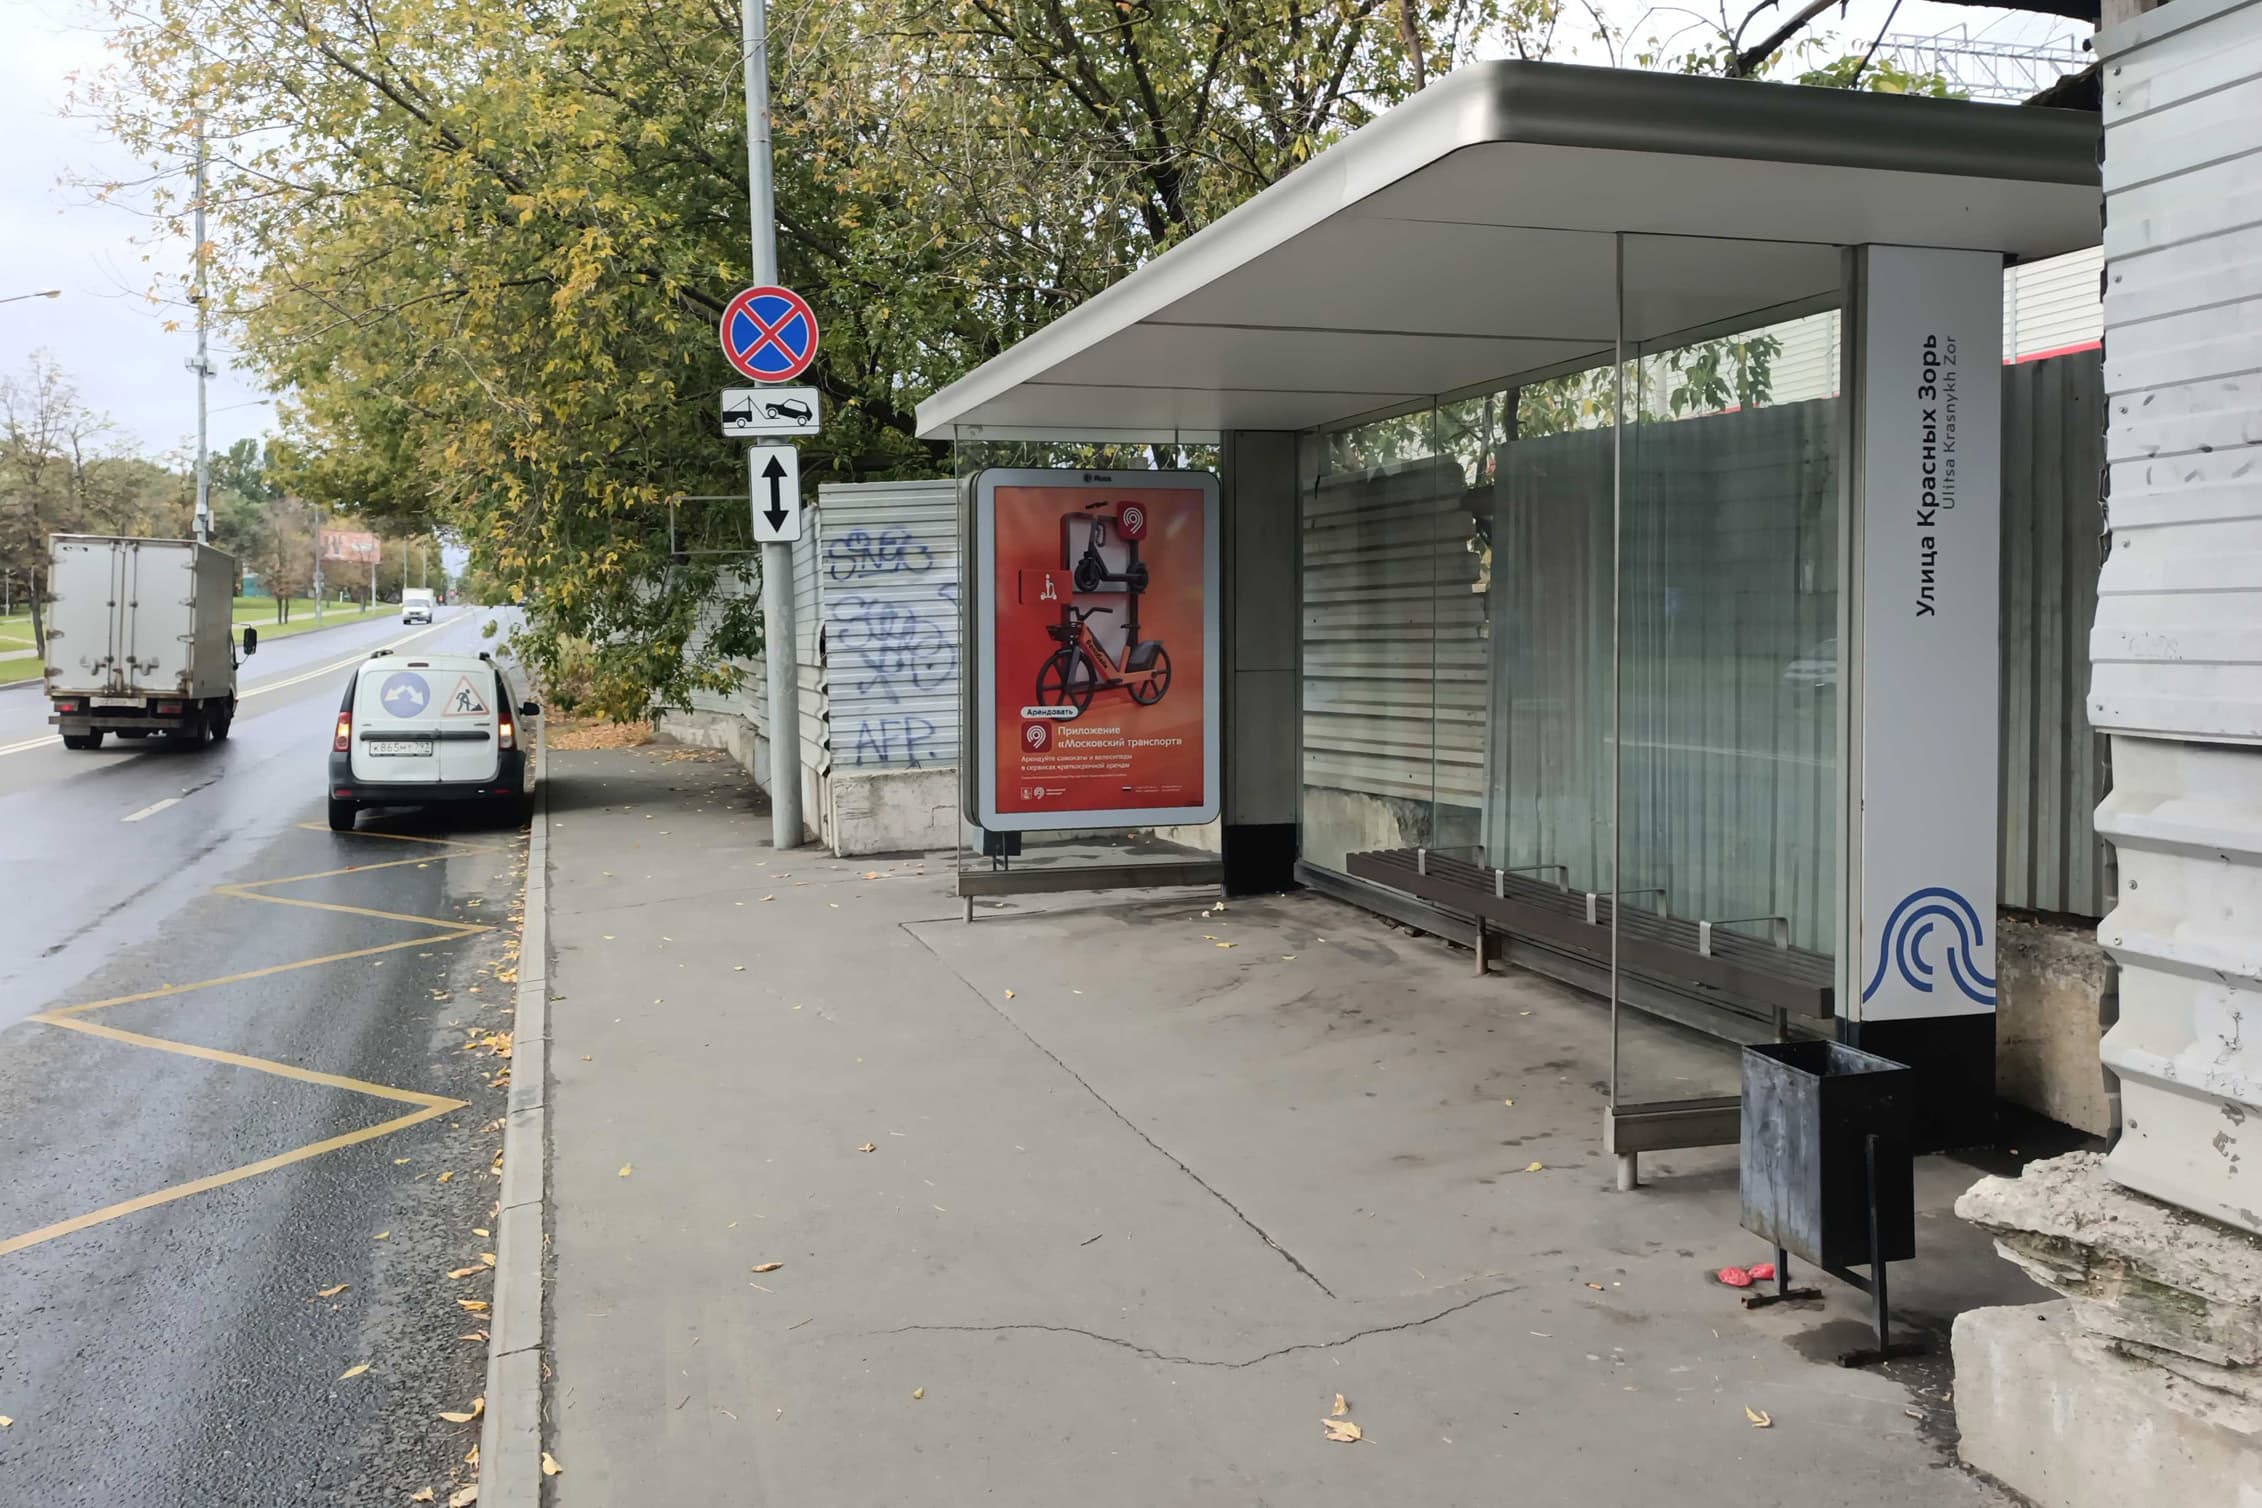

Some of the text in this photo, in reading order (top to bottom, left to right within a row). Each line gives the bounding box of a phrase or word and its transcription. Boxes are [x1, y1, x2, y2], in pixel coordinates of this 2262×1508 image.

[1942, 335, 1959, 510] Ulitsa Krasnykh Zor
[1916, 333, 1941, 617] Улица Красных Зорь
[1026, 708, 1074, 717] Арендовать
[1057, 726, 1121, 736] Приложение
[1057, 737, 1183, 748] «Московский транспорт»
